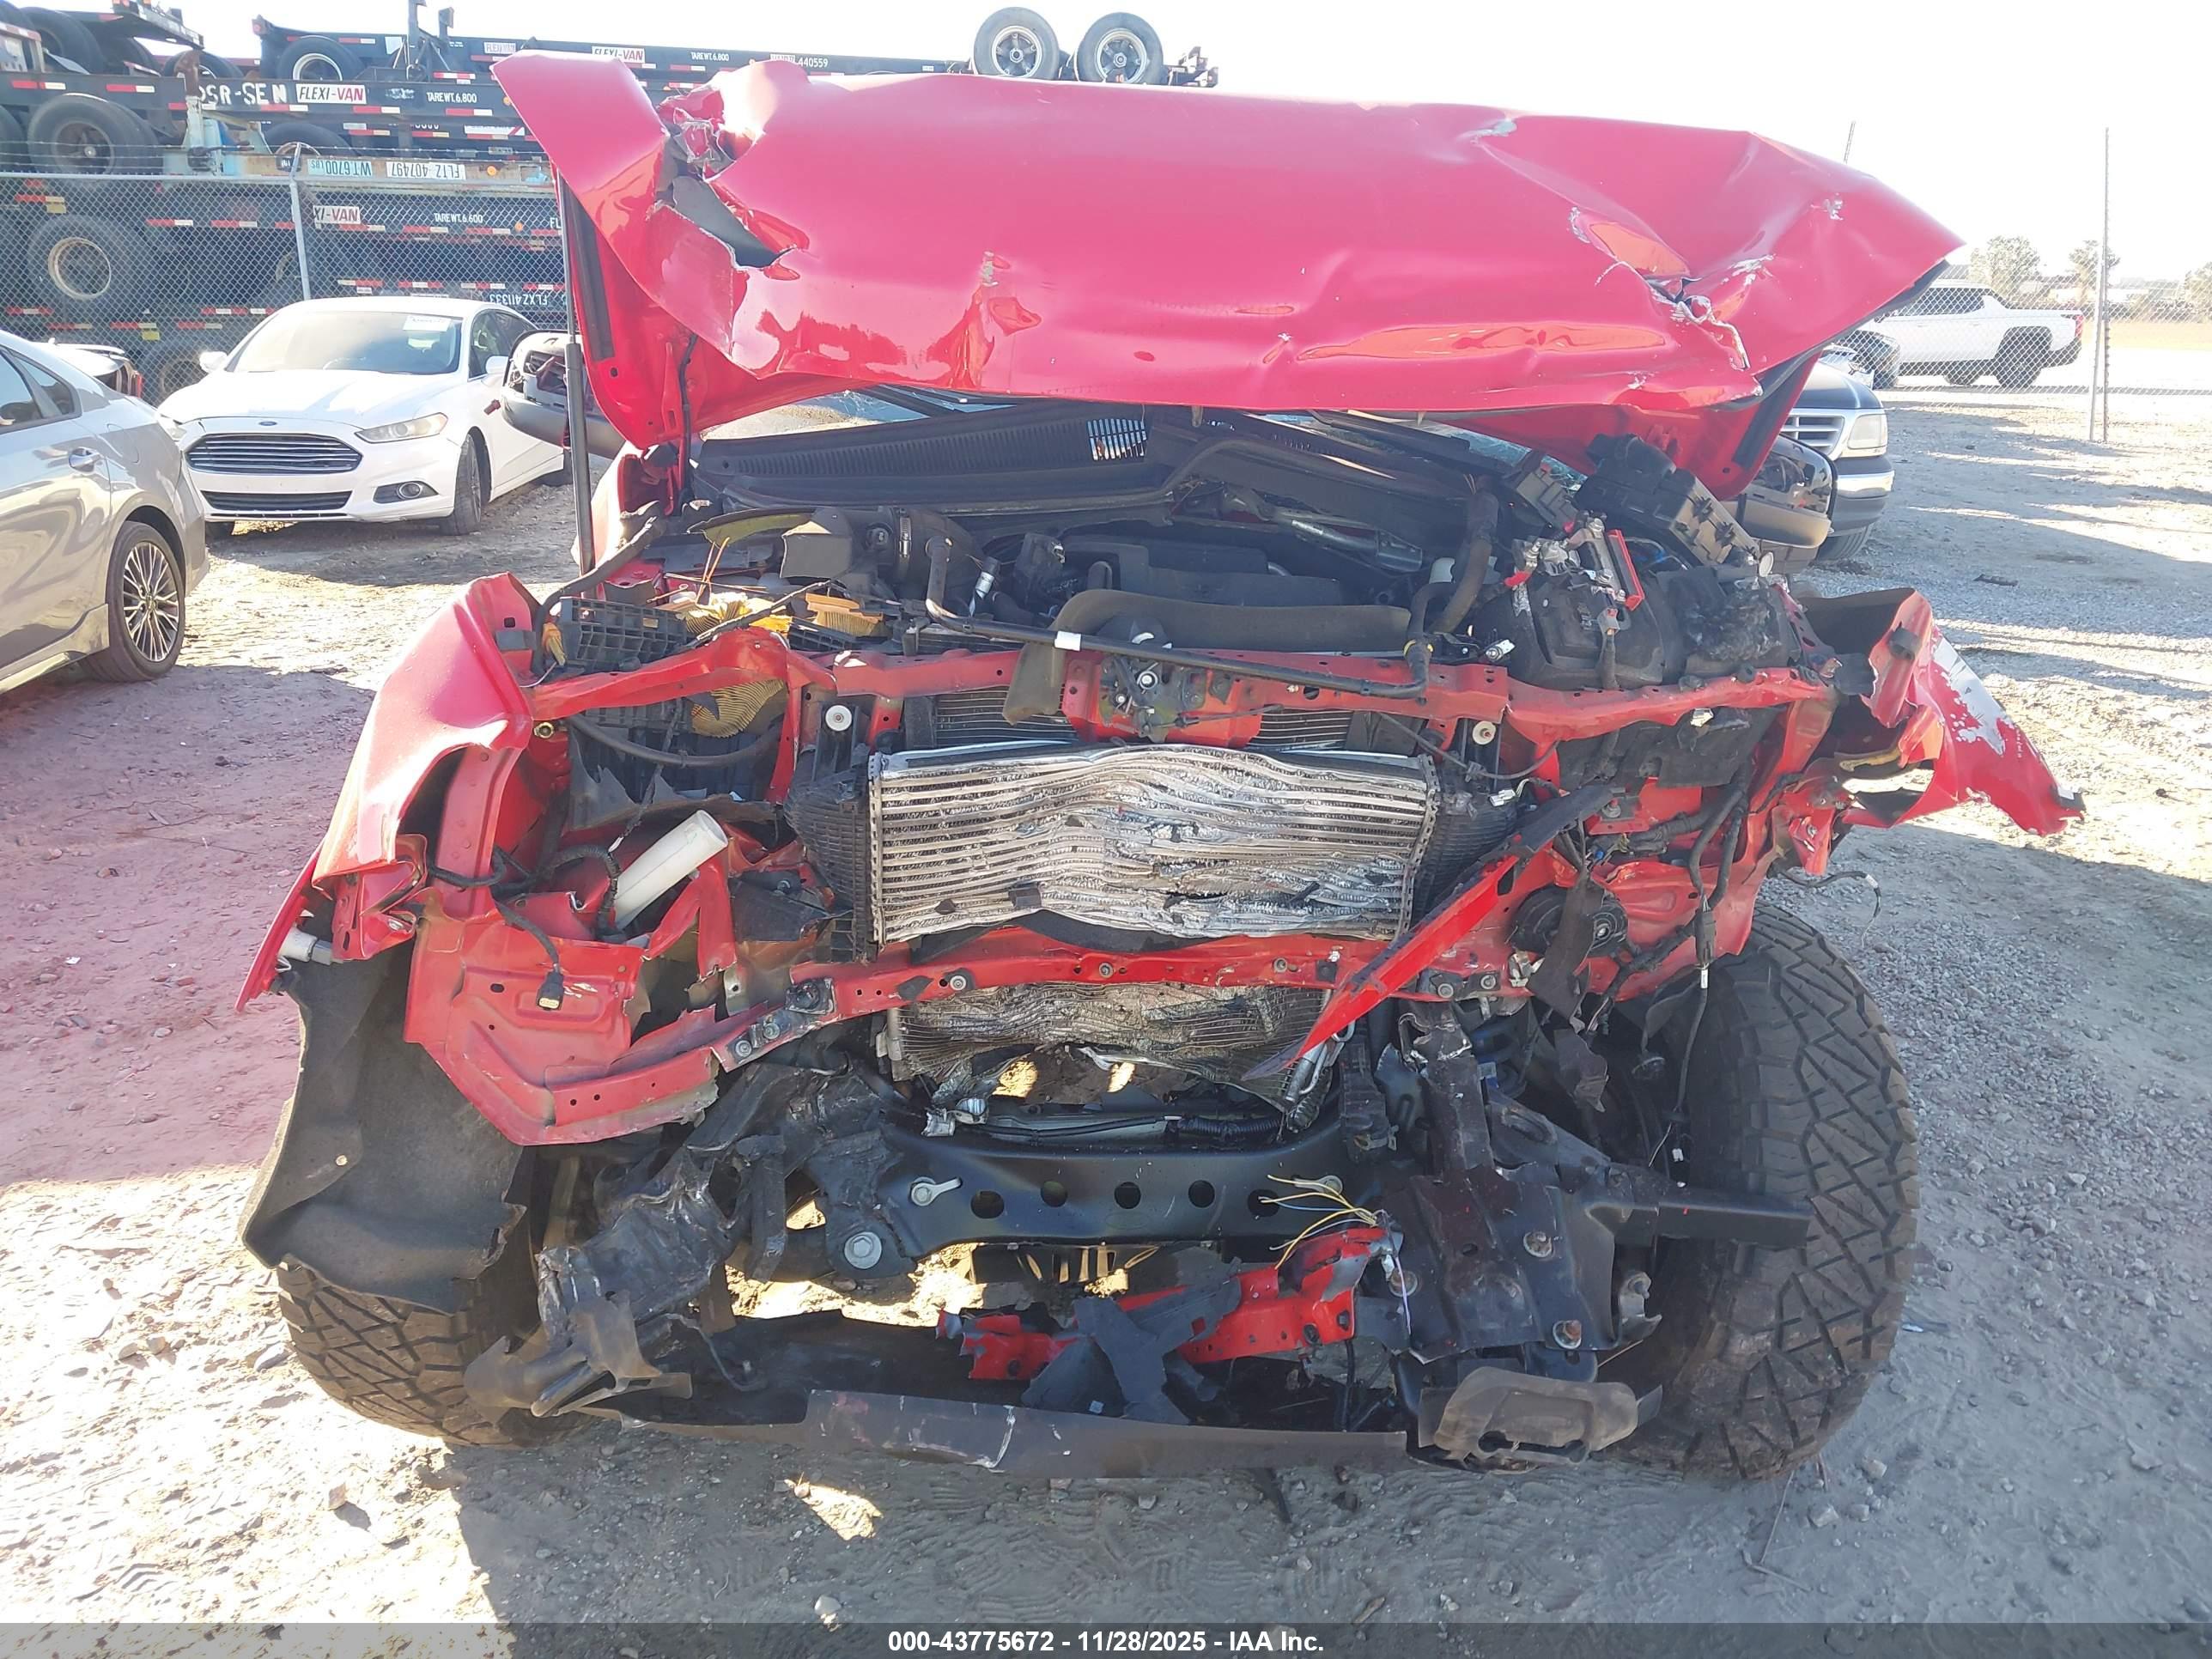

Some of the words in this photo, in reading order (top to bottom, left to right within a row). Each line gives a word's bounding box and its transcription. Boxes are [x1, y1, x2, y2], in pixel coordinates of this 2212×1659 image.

[798, 57, 829, 68] 440559
[299, 86, 364, 102] FLEXI-VAN
[392, 162, 428, 178] 407497
